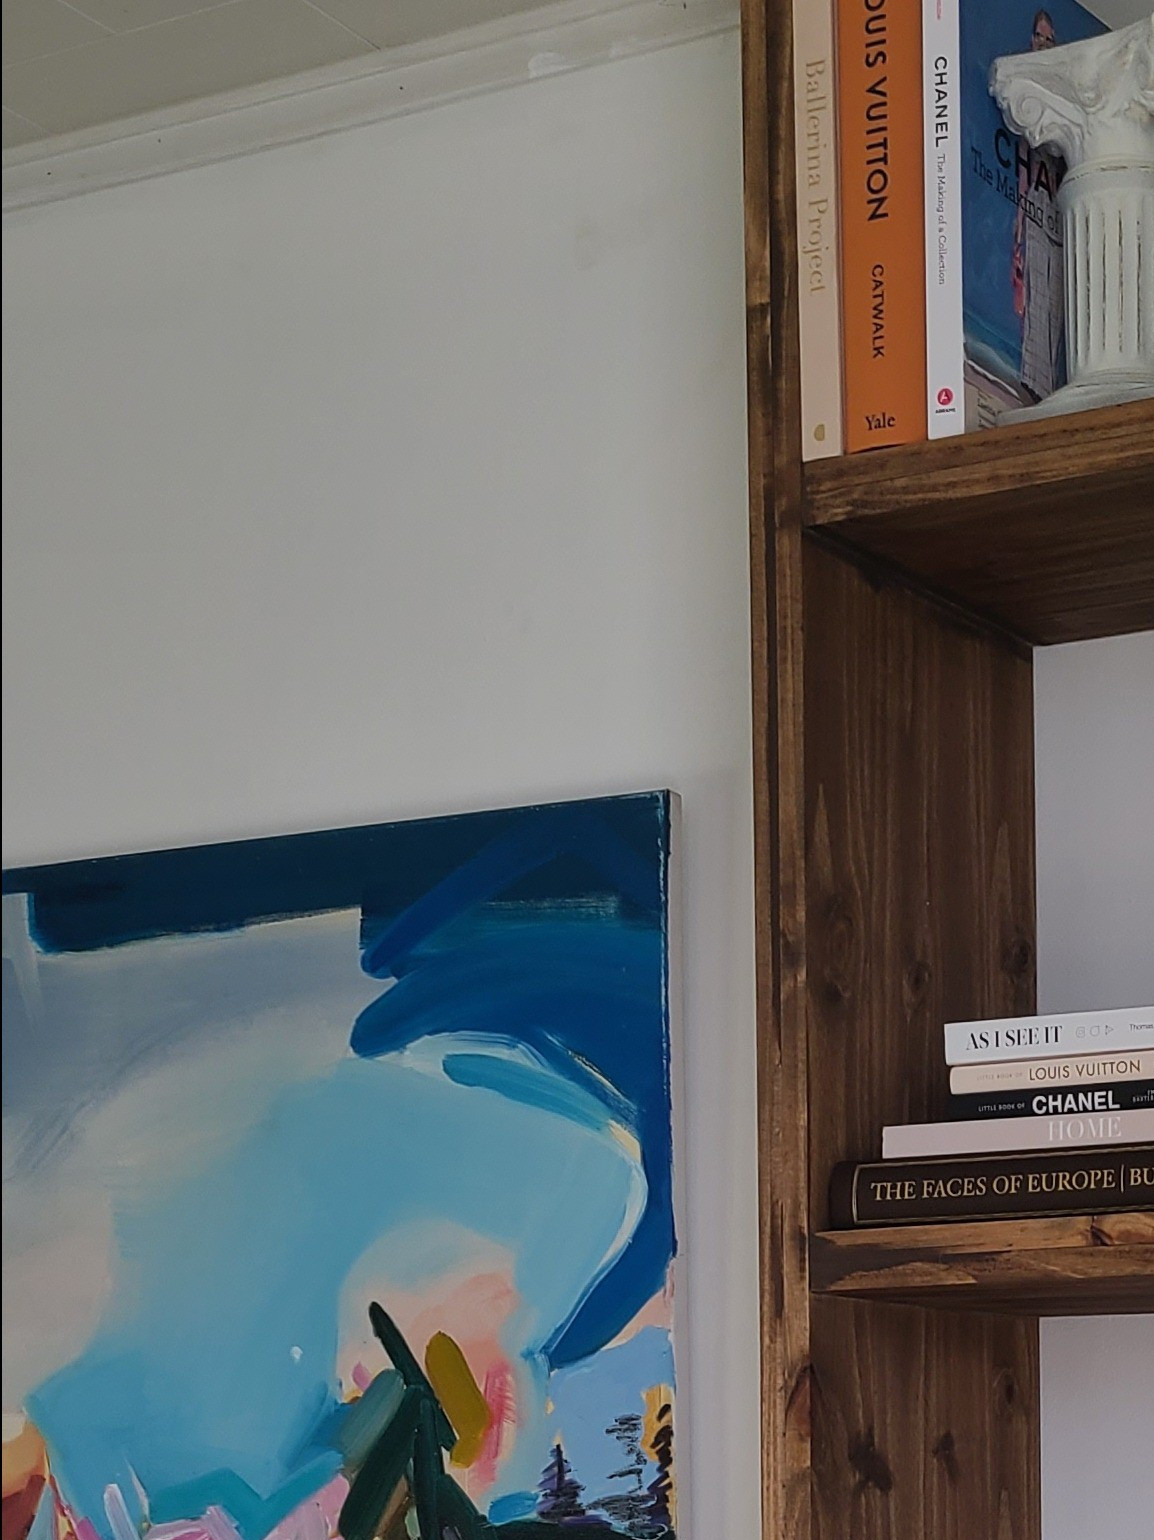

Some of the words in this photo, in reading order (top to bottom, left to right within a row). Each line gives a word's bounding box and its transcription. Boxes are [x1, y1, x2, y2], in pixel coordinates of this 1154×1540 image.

[934, 55, 949, 148] CHANEL
[805, 59, 828, 189] Ballerina
[864, 75, 889, 222] VUITTON
[937, 153, 946, 173] The
[994, 128, 1061, 202] CHA
[936, 175, 947, 213] Making
[970, 144, 993, 187] The
[995, 168, 1044, 229] Making
[938, 215, 948, 226] of
[802, 198, 830, 293] Project
[938, 235, 948, 285] Collection
[871, 263, 885, 359] CATWALK
[864, 411, 896, 431] Yale
[966, 1030, 989, 1051] AS
[995, 1030, 1000, 1048] I
[1005, 1026, 1040, 1048] SEE
[1045, 1025, 1063, 1044] IT
[1129, 1023, 1154, 1032] Thomas
[1029, 1065, 1070, 1081] LOUIS
[1075, 1059, 1141, 1078] VUITTON
[978, 1104, 997, 1113] LITTLE
[998, 1102, 1015, 1111] BOOK
[1032, 1089, 1120, 1115] CHANEL
[1048, 1116, 1122, 1142] HOME
[870, 1180, 916, 1200] THE
[921, 1176, 987, 1199] FACES
[993, 1174, 1023, 1195] OF
[1026, 1169, 1117, 1194] EUROPE
